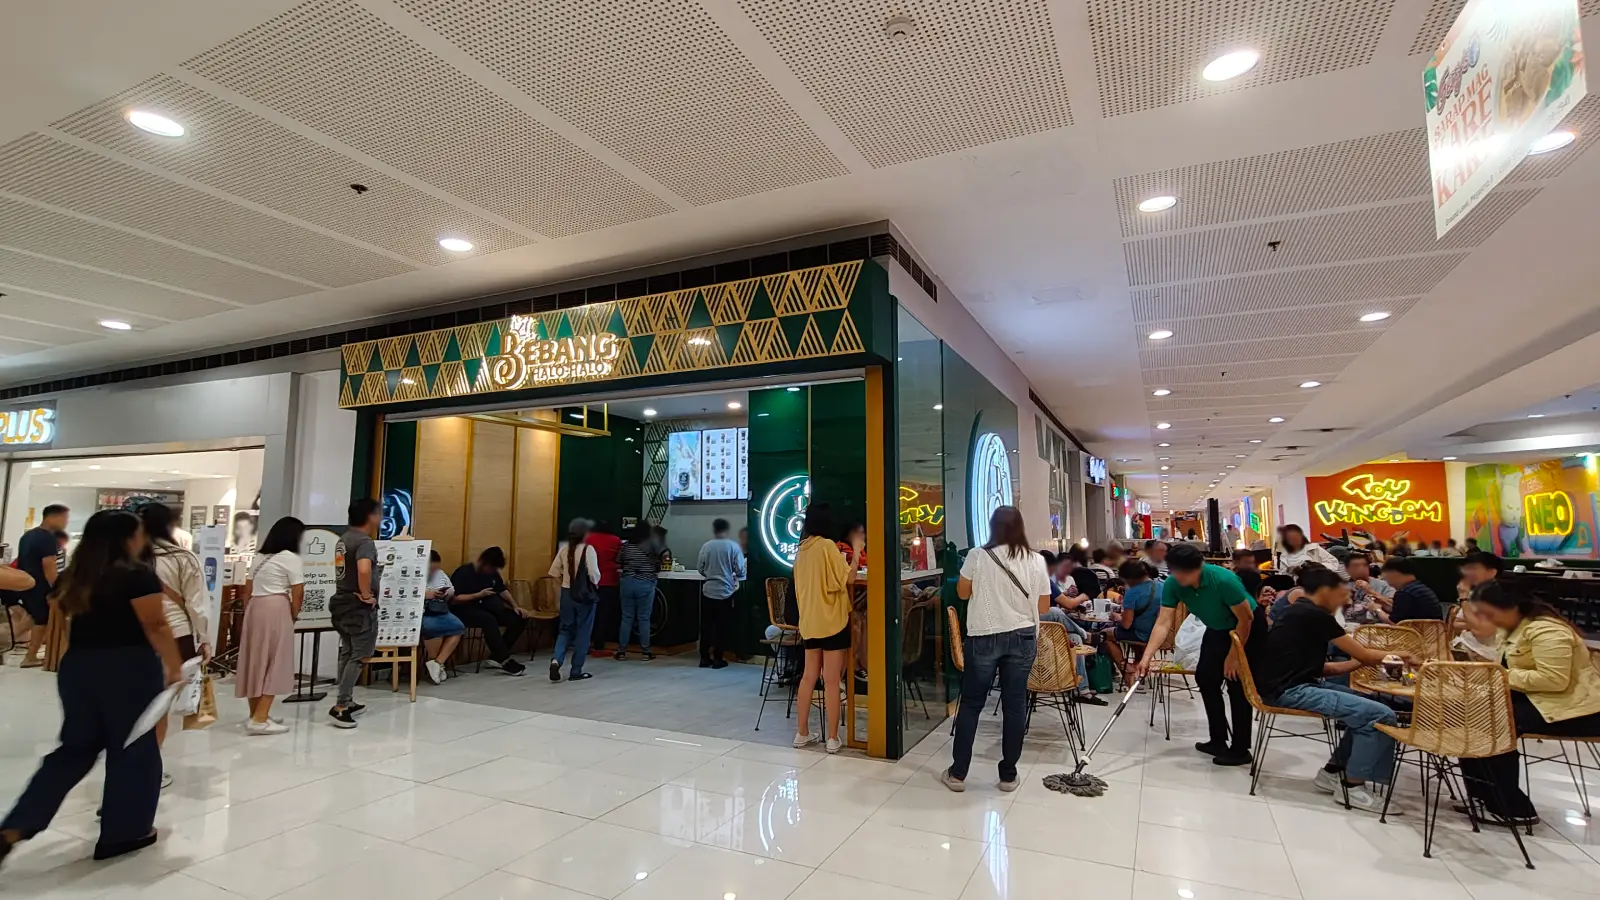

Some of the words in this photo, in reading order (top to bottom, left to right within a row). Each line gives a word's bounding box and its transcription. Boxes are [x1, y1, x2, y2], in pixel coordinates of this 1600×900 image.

[1434, 75, 1493, 150] ARE
[494, 332, 620, 389] BEBANG
[532, 361, 612, 381] HALO-HALO
[1314, 499, 1442, 526] KINGDOM
[1524, 491, 1574, 536] NEO
